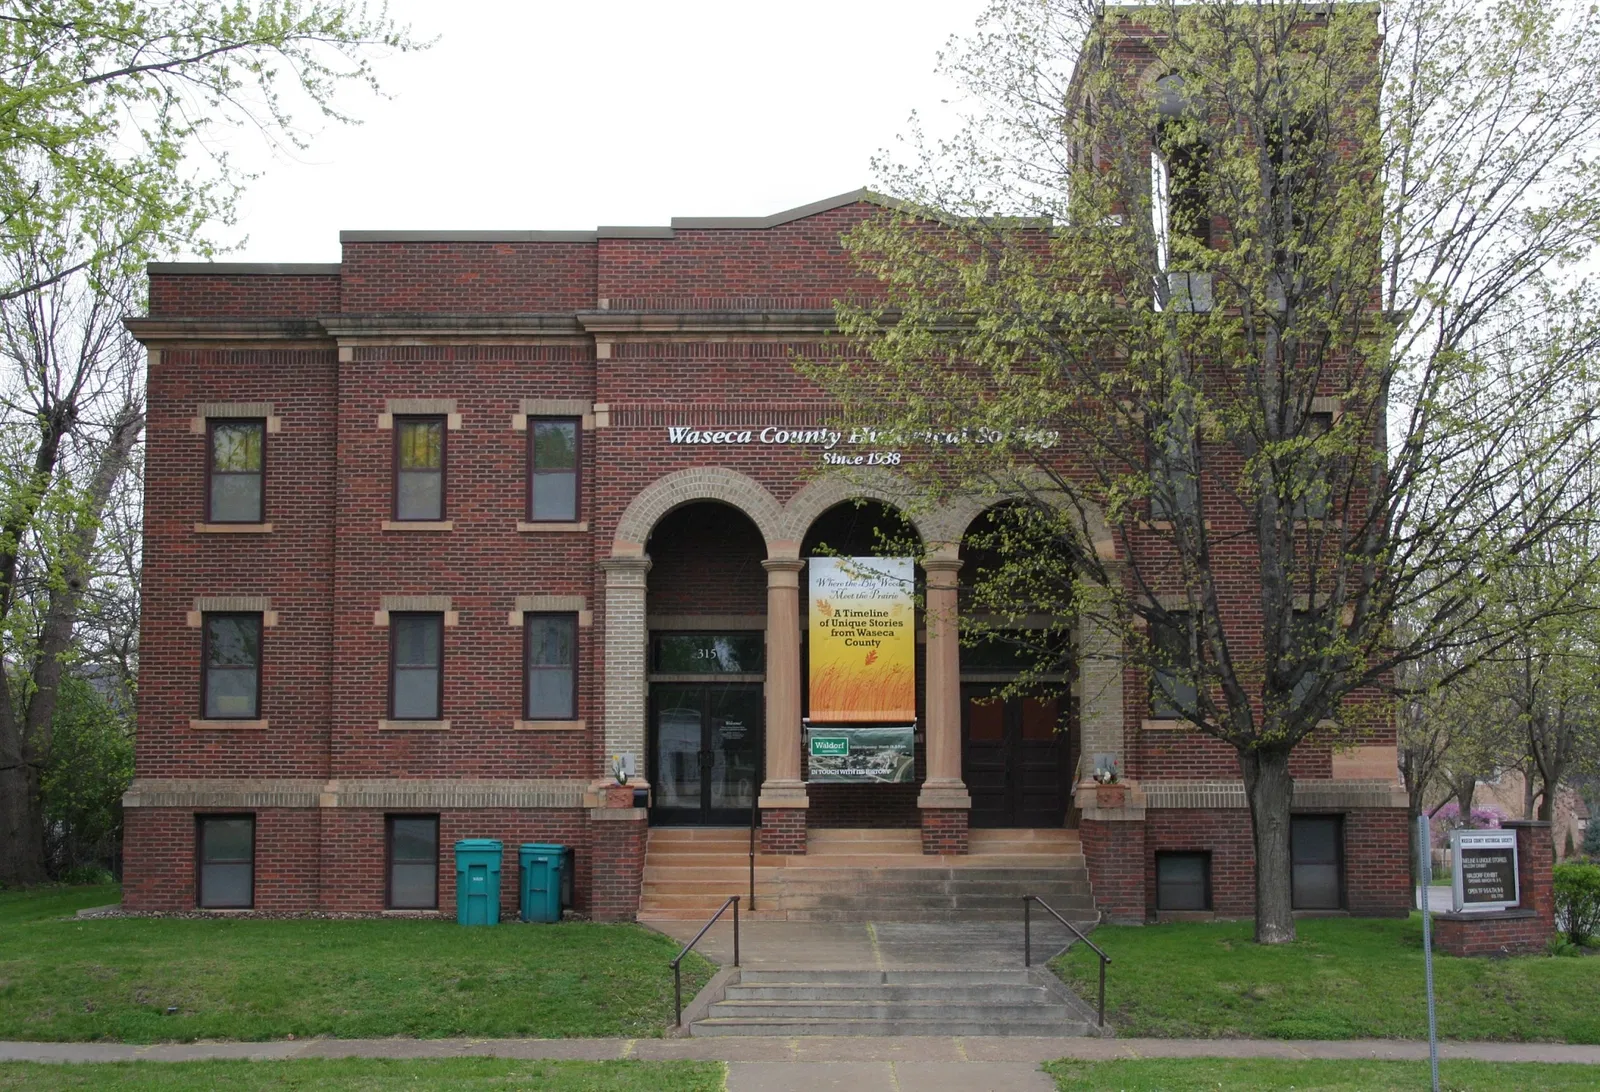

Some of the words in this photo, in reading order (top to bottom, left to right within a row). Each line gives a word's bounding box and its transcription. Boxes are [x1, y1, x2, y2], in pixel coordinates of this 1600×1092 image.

[668, 427, 752, 444] Waseca
[759, 427, 841, 449] County
[823, 452, 863, 465] Since
[867, 452, 901, 465] 1938
[816, 578, 843, 588] Where
[844, 579, 856, 588] the
[858, 579, 876, 590] Big
[829, 588, 854, 600] Meet
[856, 590, 868, 600] the
[869, 589, 899, 600] Prairie
[834, 609, 841, 618] A
[843, 609, 889, 618] Timeline
[820, 619, 830, 627] of
[831, 619, 867, 630] Unique
[869, 619, 904, 627] Stories
[830, 629, 855, 637] from
[856, 629, 894, 637] Waseca
[844, 638, 881, 649] County
[697, 648, 717, 660] 315
[815, 741, 845, 749] Waldorf
